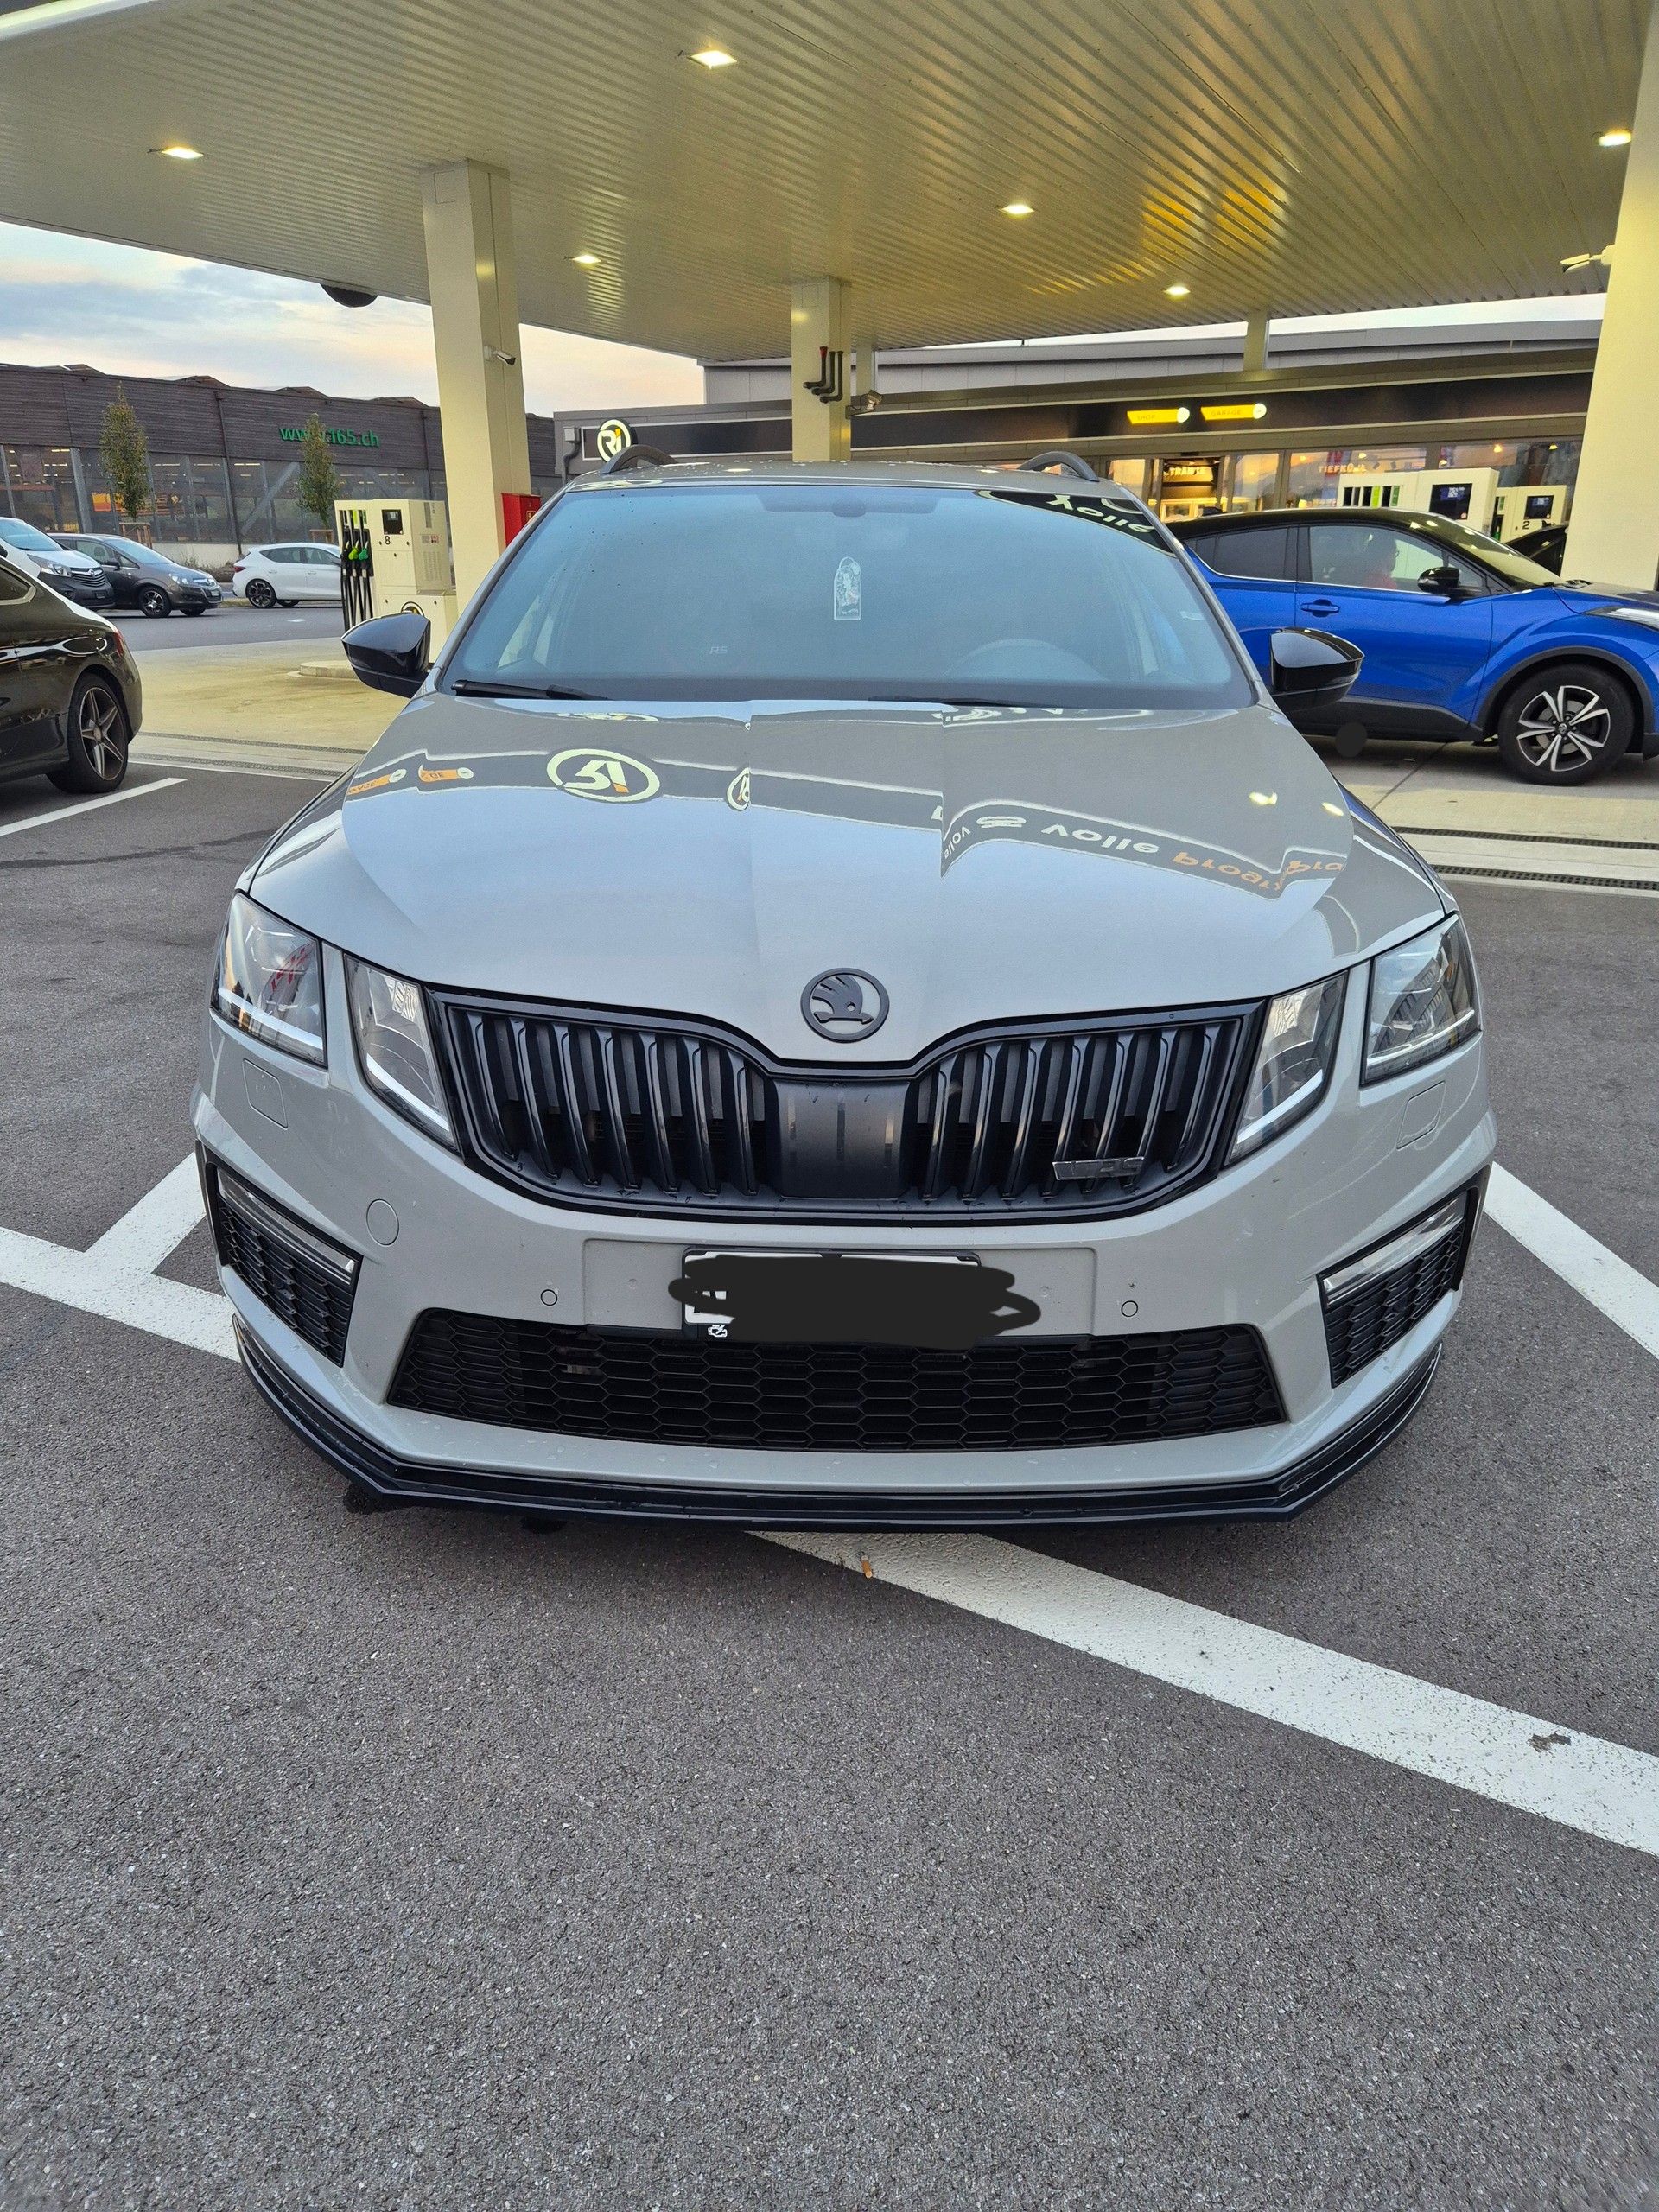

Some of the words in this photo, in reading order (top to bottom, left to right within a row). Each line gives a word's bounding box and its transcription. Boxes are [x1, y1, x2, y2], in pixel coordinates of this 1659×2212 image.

[279, 428, 380, 447] ww.165.ch
[1522, 520, 1530, 530] 2
[385, 536, 391, 545] 8
[709, 645, 728, 655] RS
